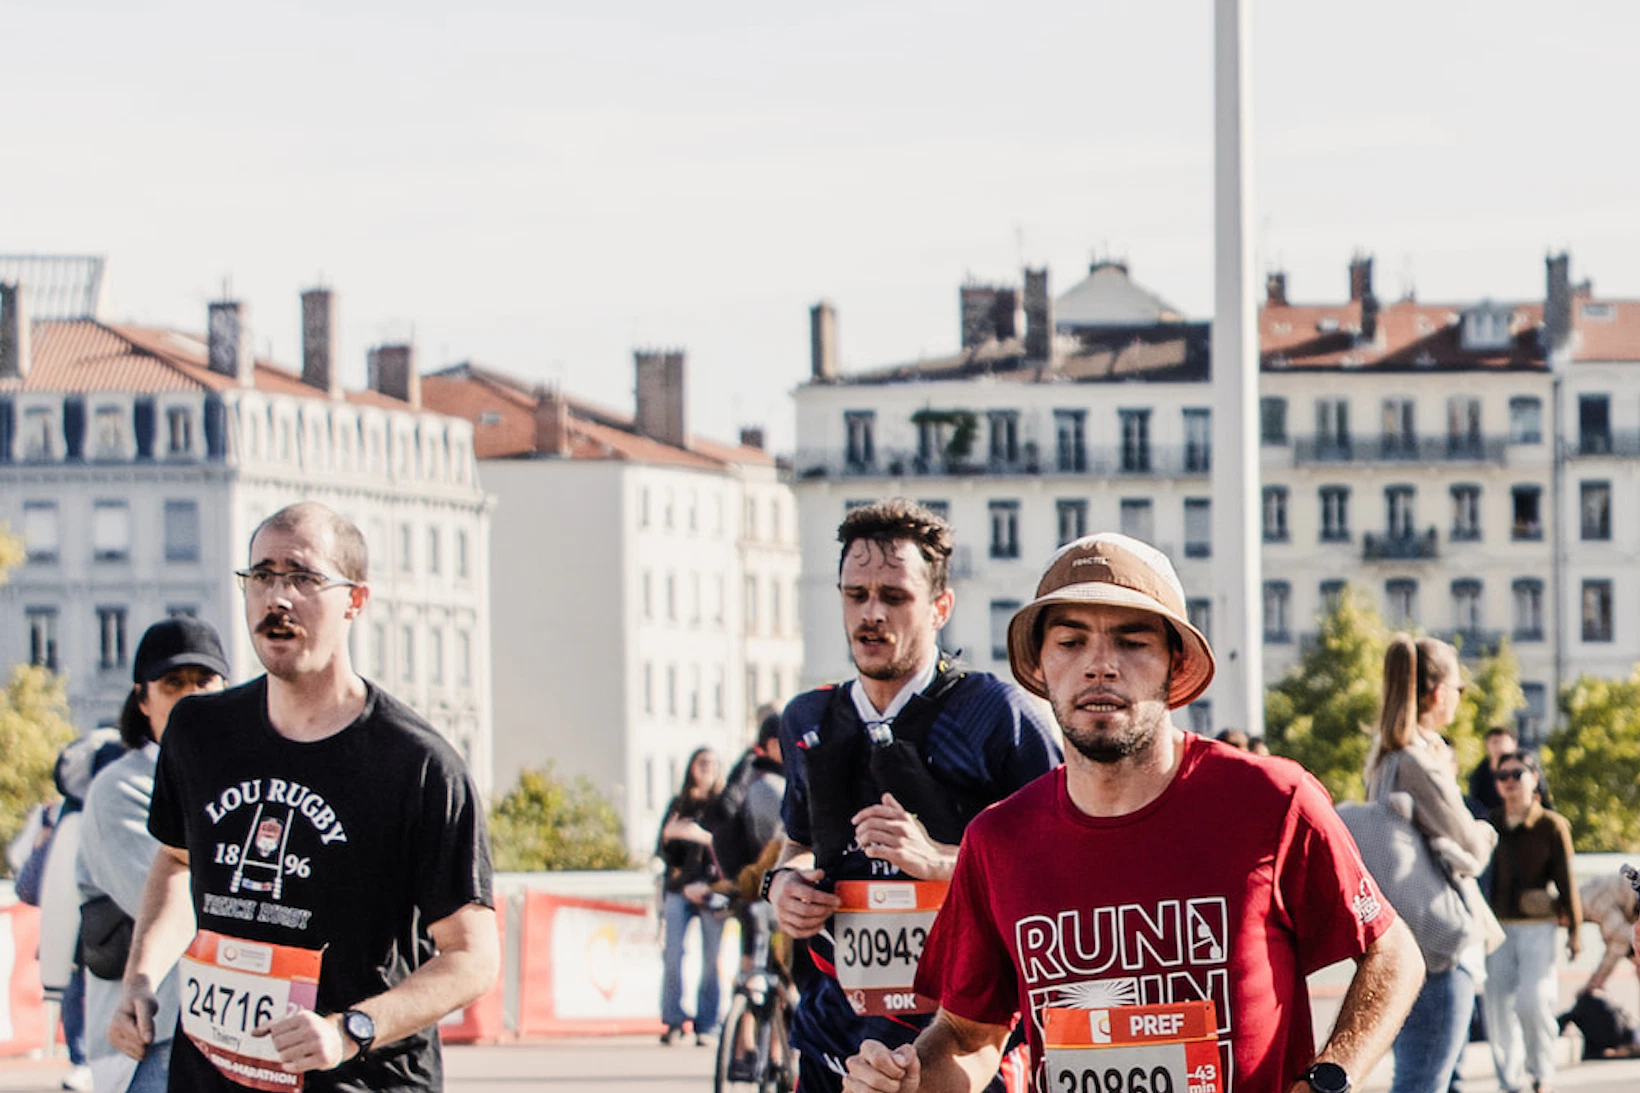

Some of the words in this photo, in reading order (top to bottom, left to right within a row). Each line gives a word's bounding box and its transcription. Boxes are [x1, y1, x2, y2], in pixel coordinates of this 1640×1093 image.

[205, 779, 262, 824] LOU
[265, 778, 347, 845] RUGBY
[214, 843, 241, 865] 18
[284, 854, 311, 878] 96
[1015, 899, 1184, 983] RUN
[187, 976, 274, 1033] 24716
[882, 993, 916, 1010] 10K
[1129, 1013, 1185, 1037] PREF
[1187, 1064, 1217, 1081] -43
